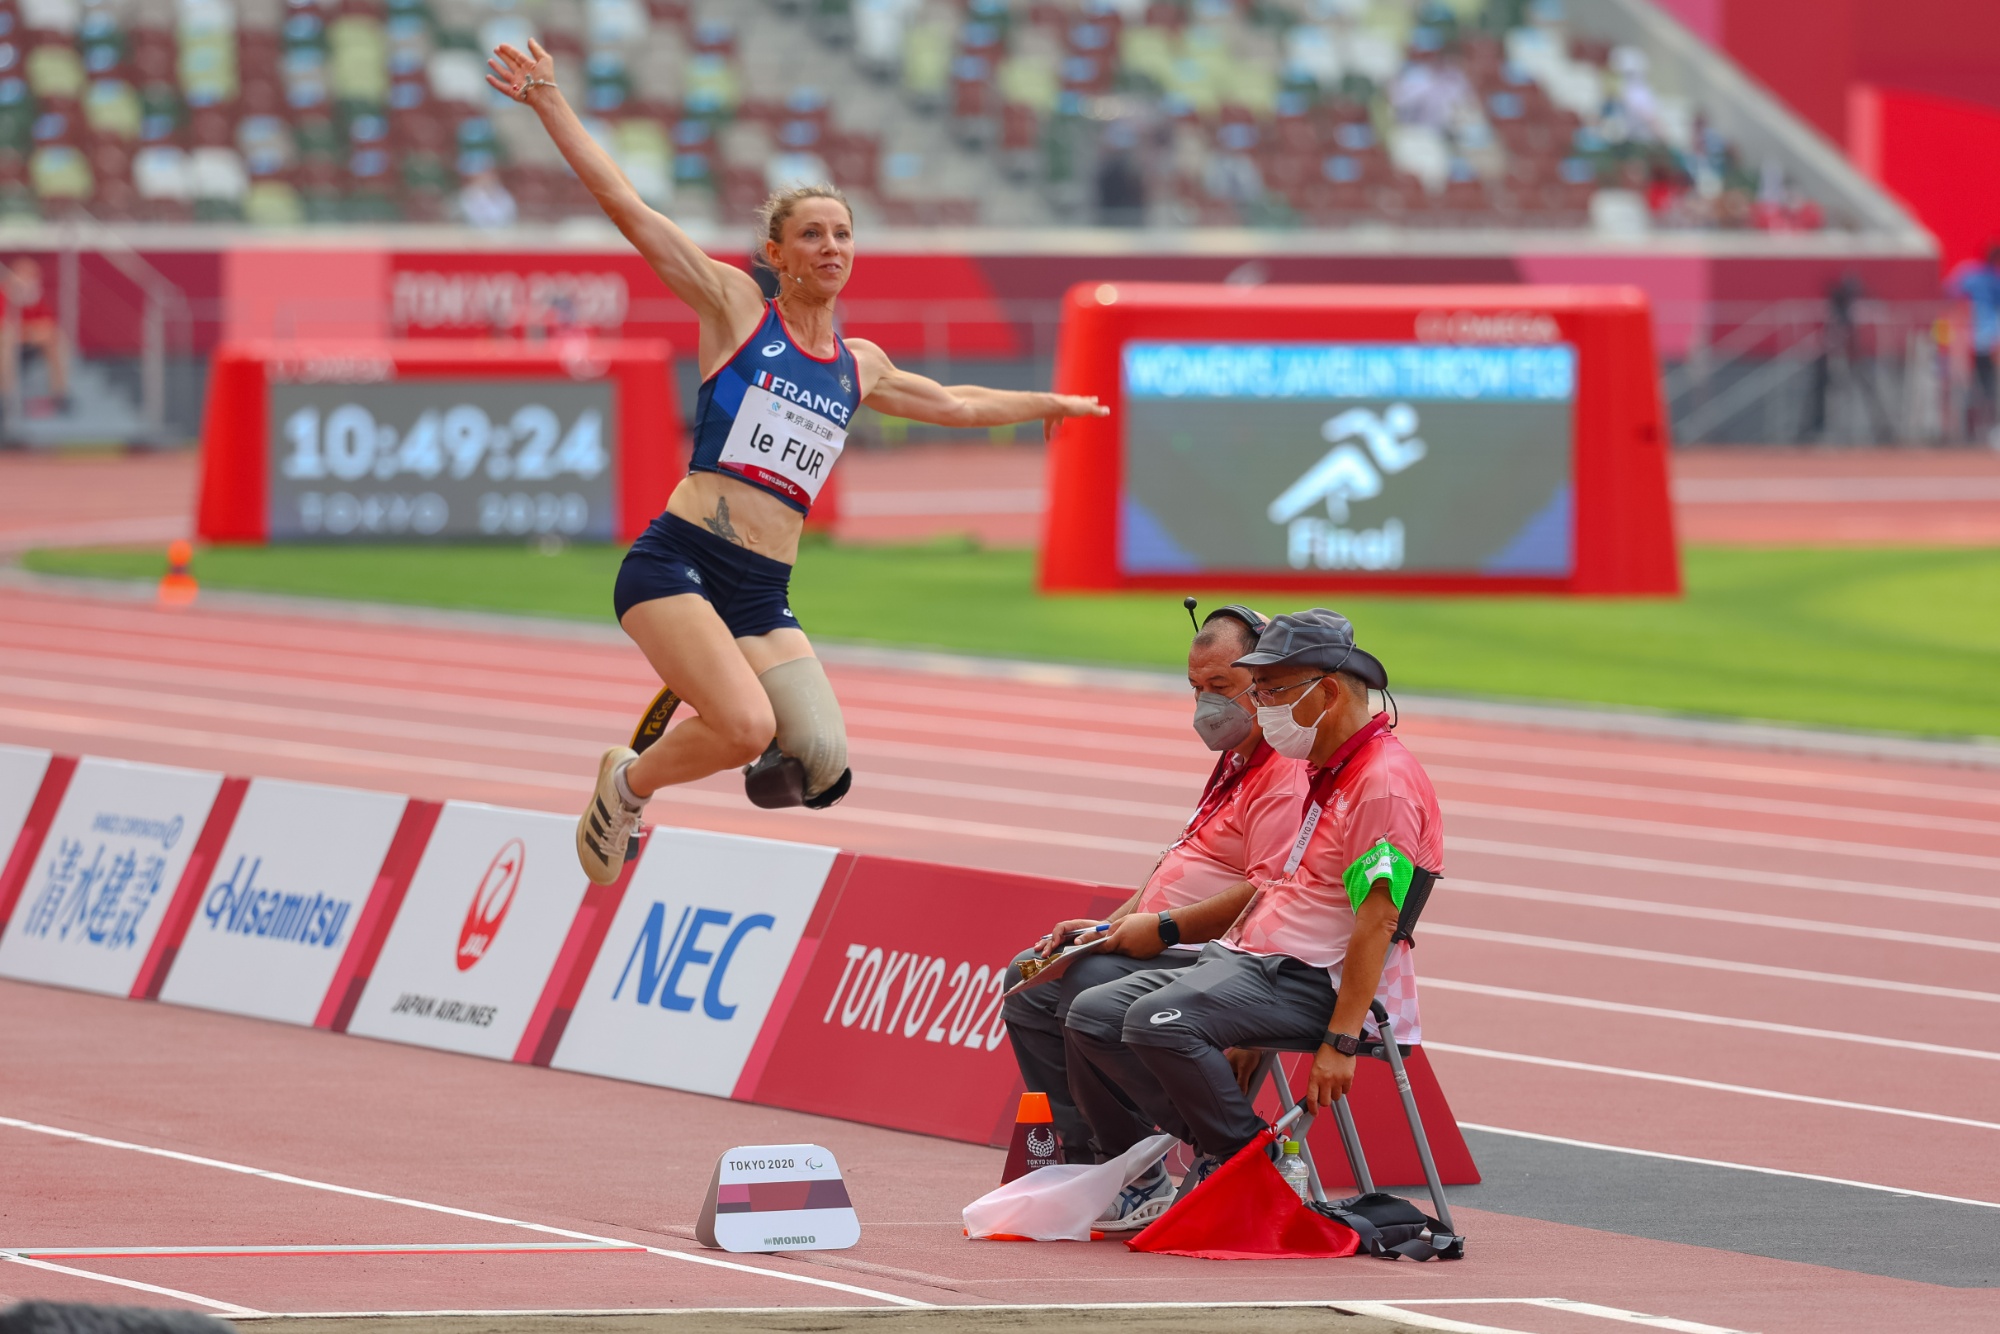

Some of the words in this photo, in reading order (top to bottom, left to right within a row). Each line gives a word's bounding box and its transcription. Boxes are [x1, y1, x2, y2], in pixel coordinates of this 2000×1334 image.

[393, 270, 523, 329] TOKYO
[769, 375, 850, 426] FRANCE
[784, 409, 834, 442] 東京海上日動
[282, 403, 610, 481] 10:49:24
[749, 422, 775, 454] le
[780, 436, 825, 480] FUR
[297, 491, 450, 535] TOKYO
[478, 491, 589, 535] 2020
[1287, 515, 1405, 571] Final
[1296, 824, 1312, 850] TOKYO
[1307, 807, 1320, 828] 2020
[611, 901, 776, 1021] NEC
[391, 992, 436, 1018] JAPAN
[435, 998, 497, 1028] AIRLINES
[823, 943, 947, 1039] TOKYO
[729, 1160, 766, 1171] TOKYO
[768, 1158, 795, 1170] 2020
[772, 1235, 817, 1246] MONDO
